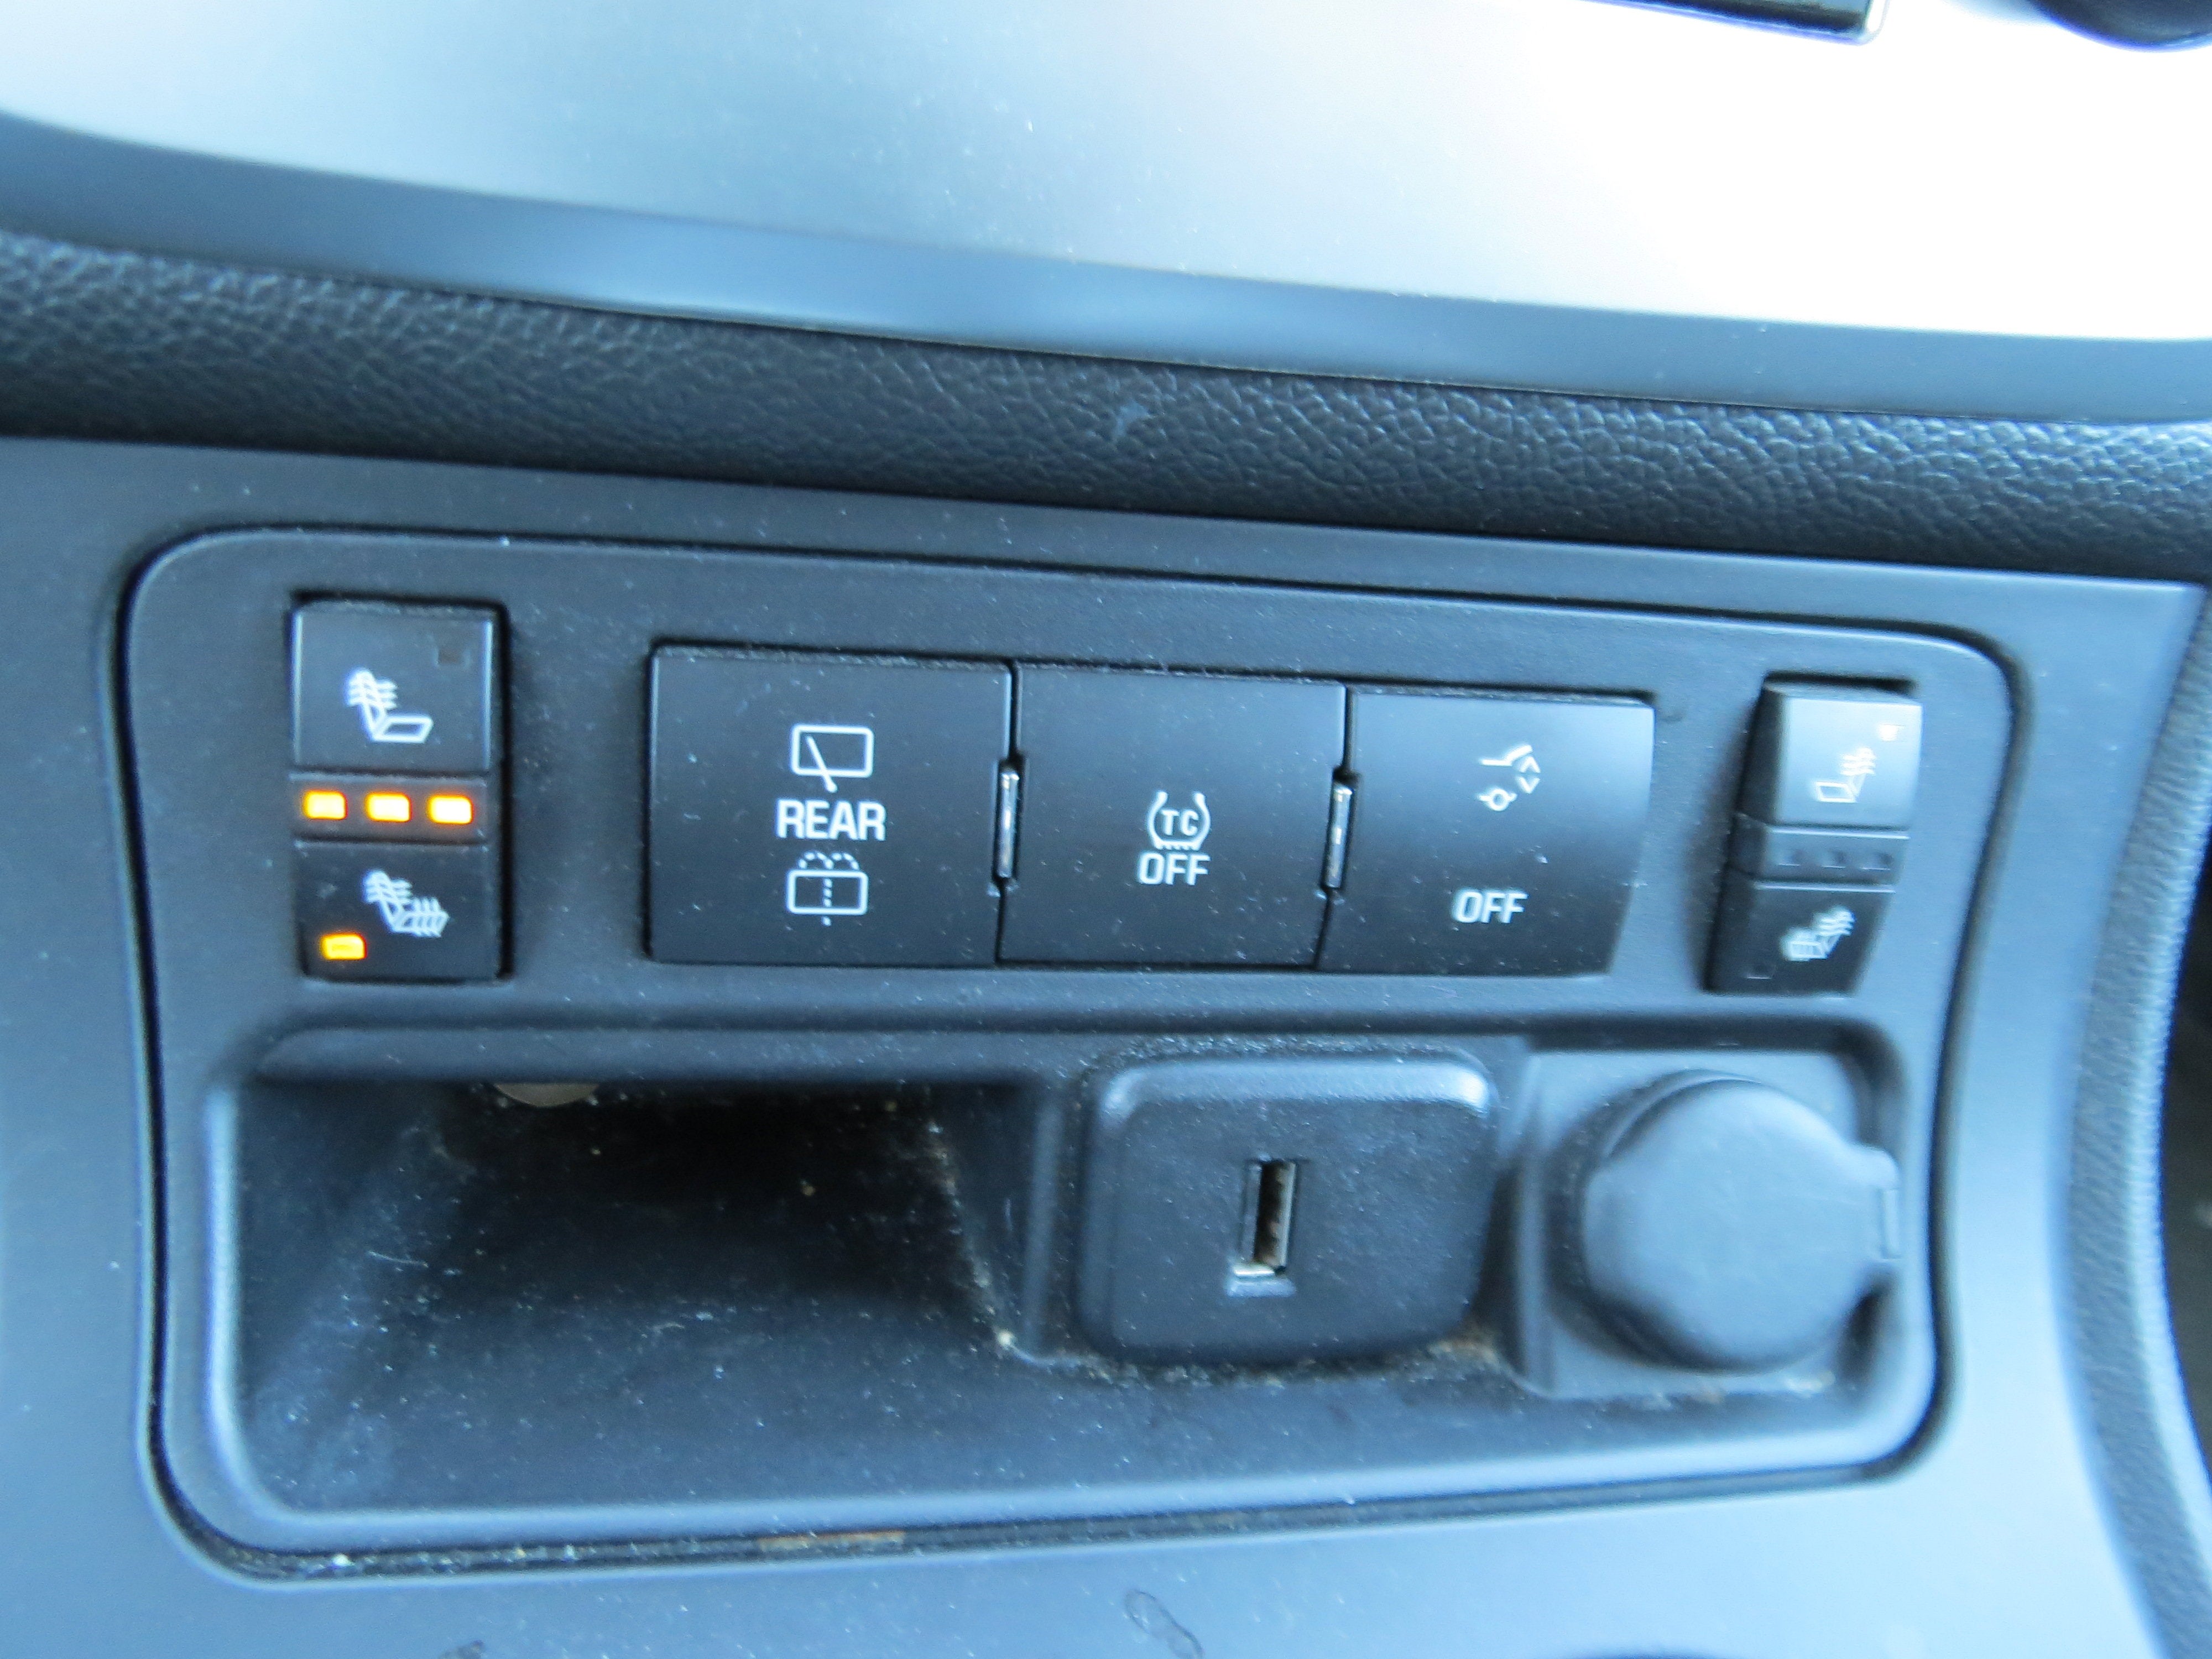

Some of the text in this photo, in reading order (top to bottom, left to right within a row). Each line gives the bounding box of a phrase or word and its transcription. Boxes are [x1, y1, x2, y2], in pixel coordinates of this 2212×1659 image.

[776, 799, 886, 841] REAR
[1161, 808, 1199, 836] TC
[1138, 852, 1211, 885] OFF
[1452, 889, 1528, 924] OFF
